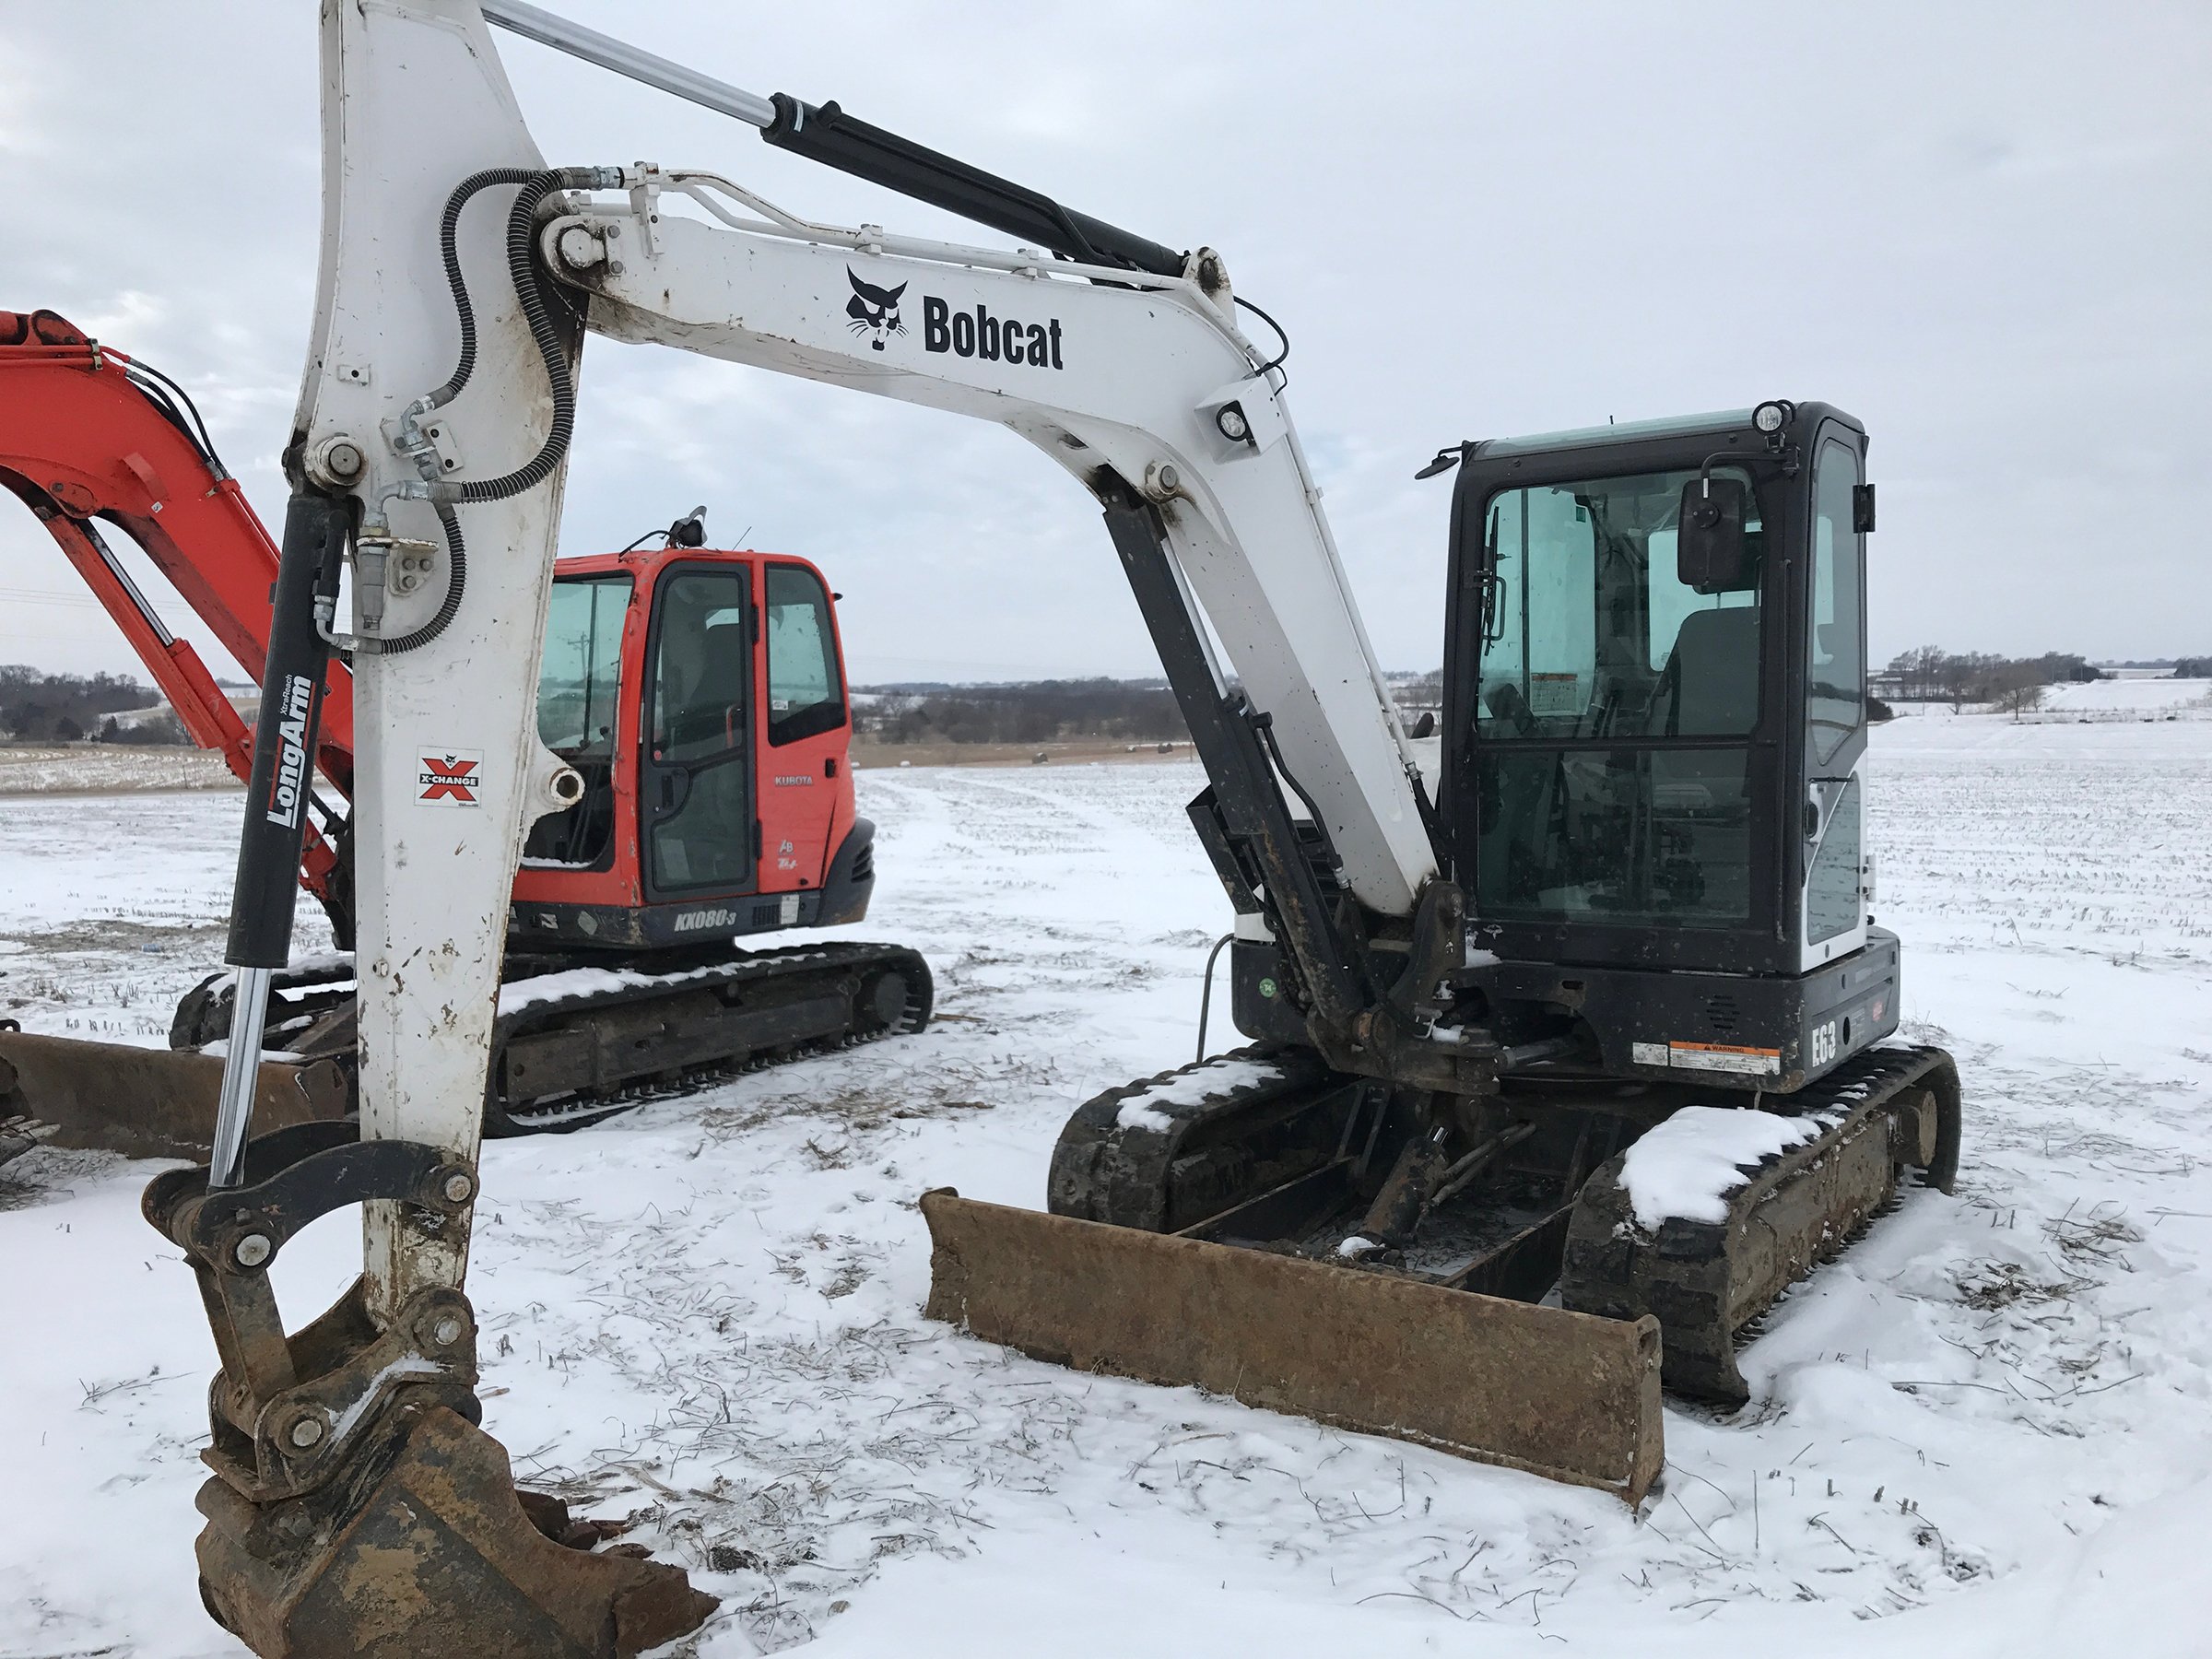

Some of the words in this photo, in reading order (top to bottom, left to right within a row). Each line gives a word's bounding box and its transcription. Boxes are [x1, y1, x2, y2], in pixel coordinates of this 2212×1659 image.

[924, 295, 1063, 370] Bobcat
[280, 674, 293, 715] XtraReach
[266, 675, 312, 829] LongArm
[420, 775, 476, 785] X-CHANGE
[774, 776, 813, 785] KUBOTA
[674, 909, 737, 932] KX080-3
[1812, 1020, 1836, 1067] E63
